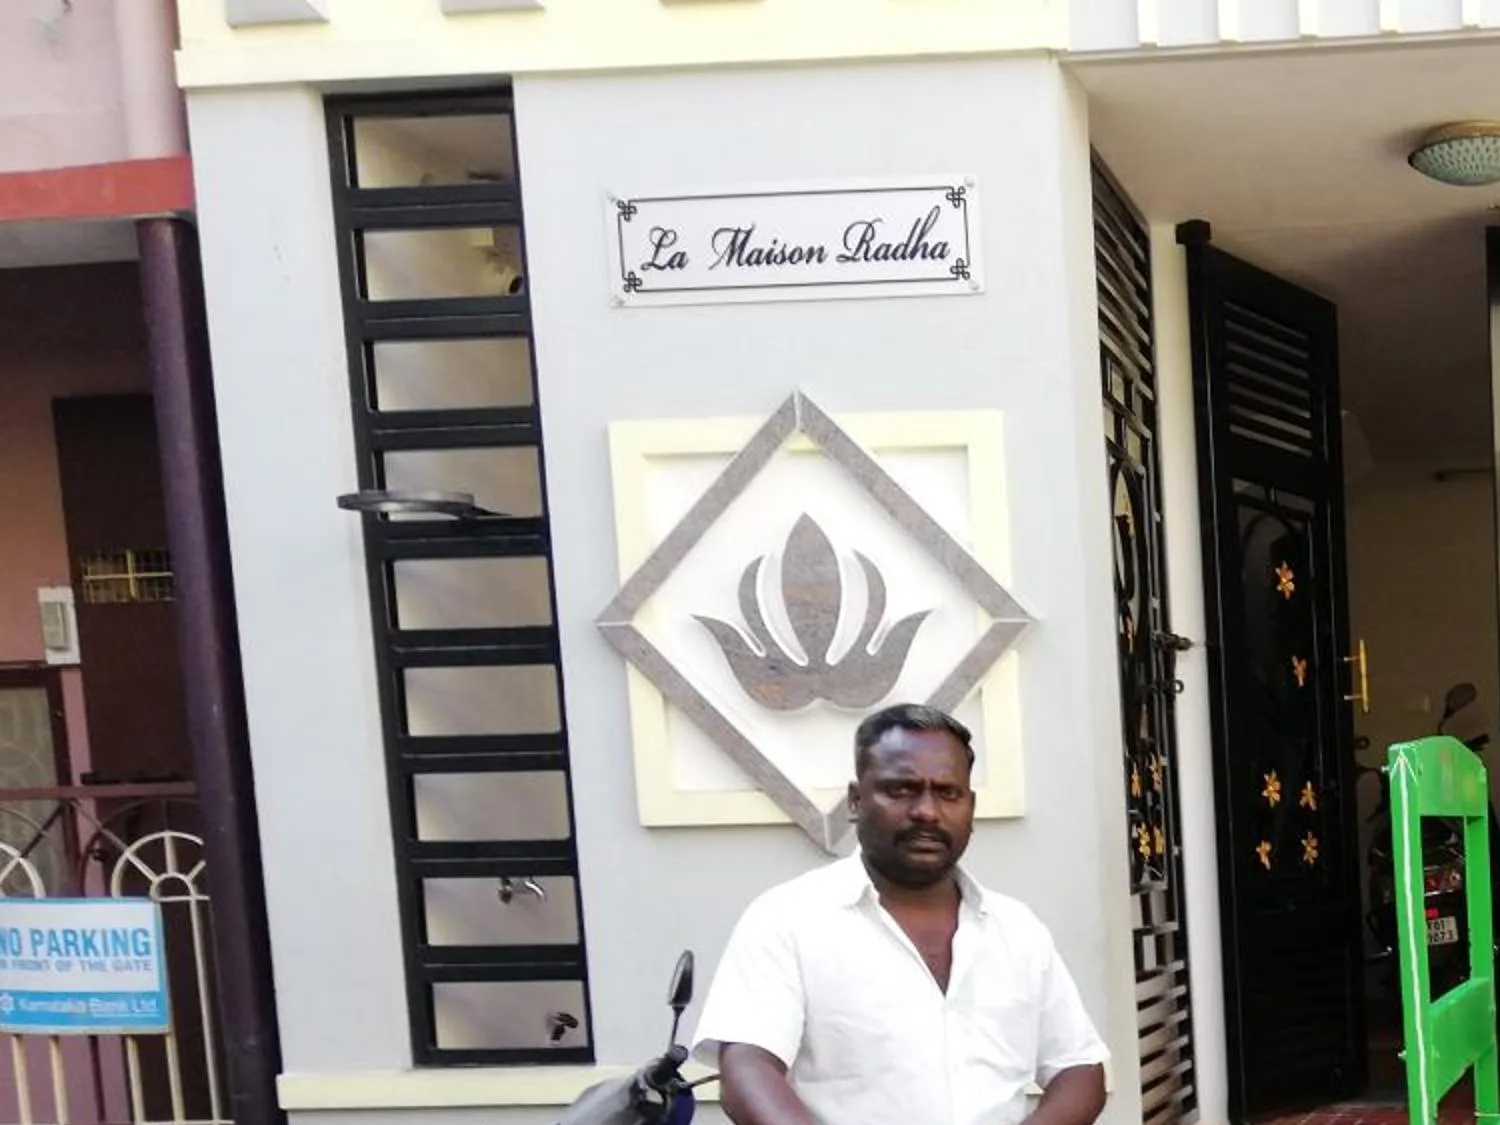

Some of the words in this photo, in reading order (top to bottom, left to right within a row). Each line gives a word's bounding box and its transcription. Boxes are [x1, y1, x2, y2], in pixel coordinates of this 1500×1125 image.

[641, 226, 688, 271] La
[708, 224, 826, 270] Maison
[836, 205, 949, 263] Radha
[30, 928, 150, 957] PARKING
[55, 959, 73, 973] OF
[80, 959, 108, 973] THE
[112, 959, 153, 973] GATE
